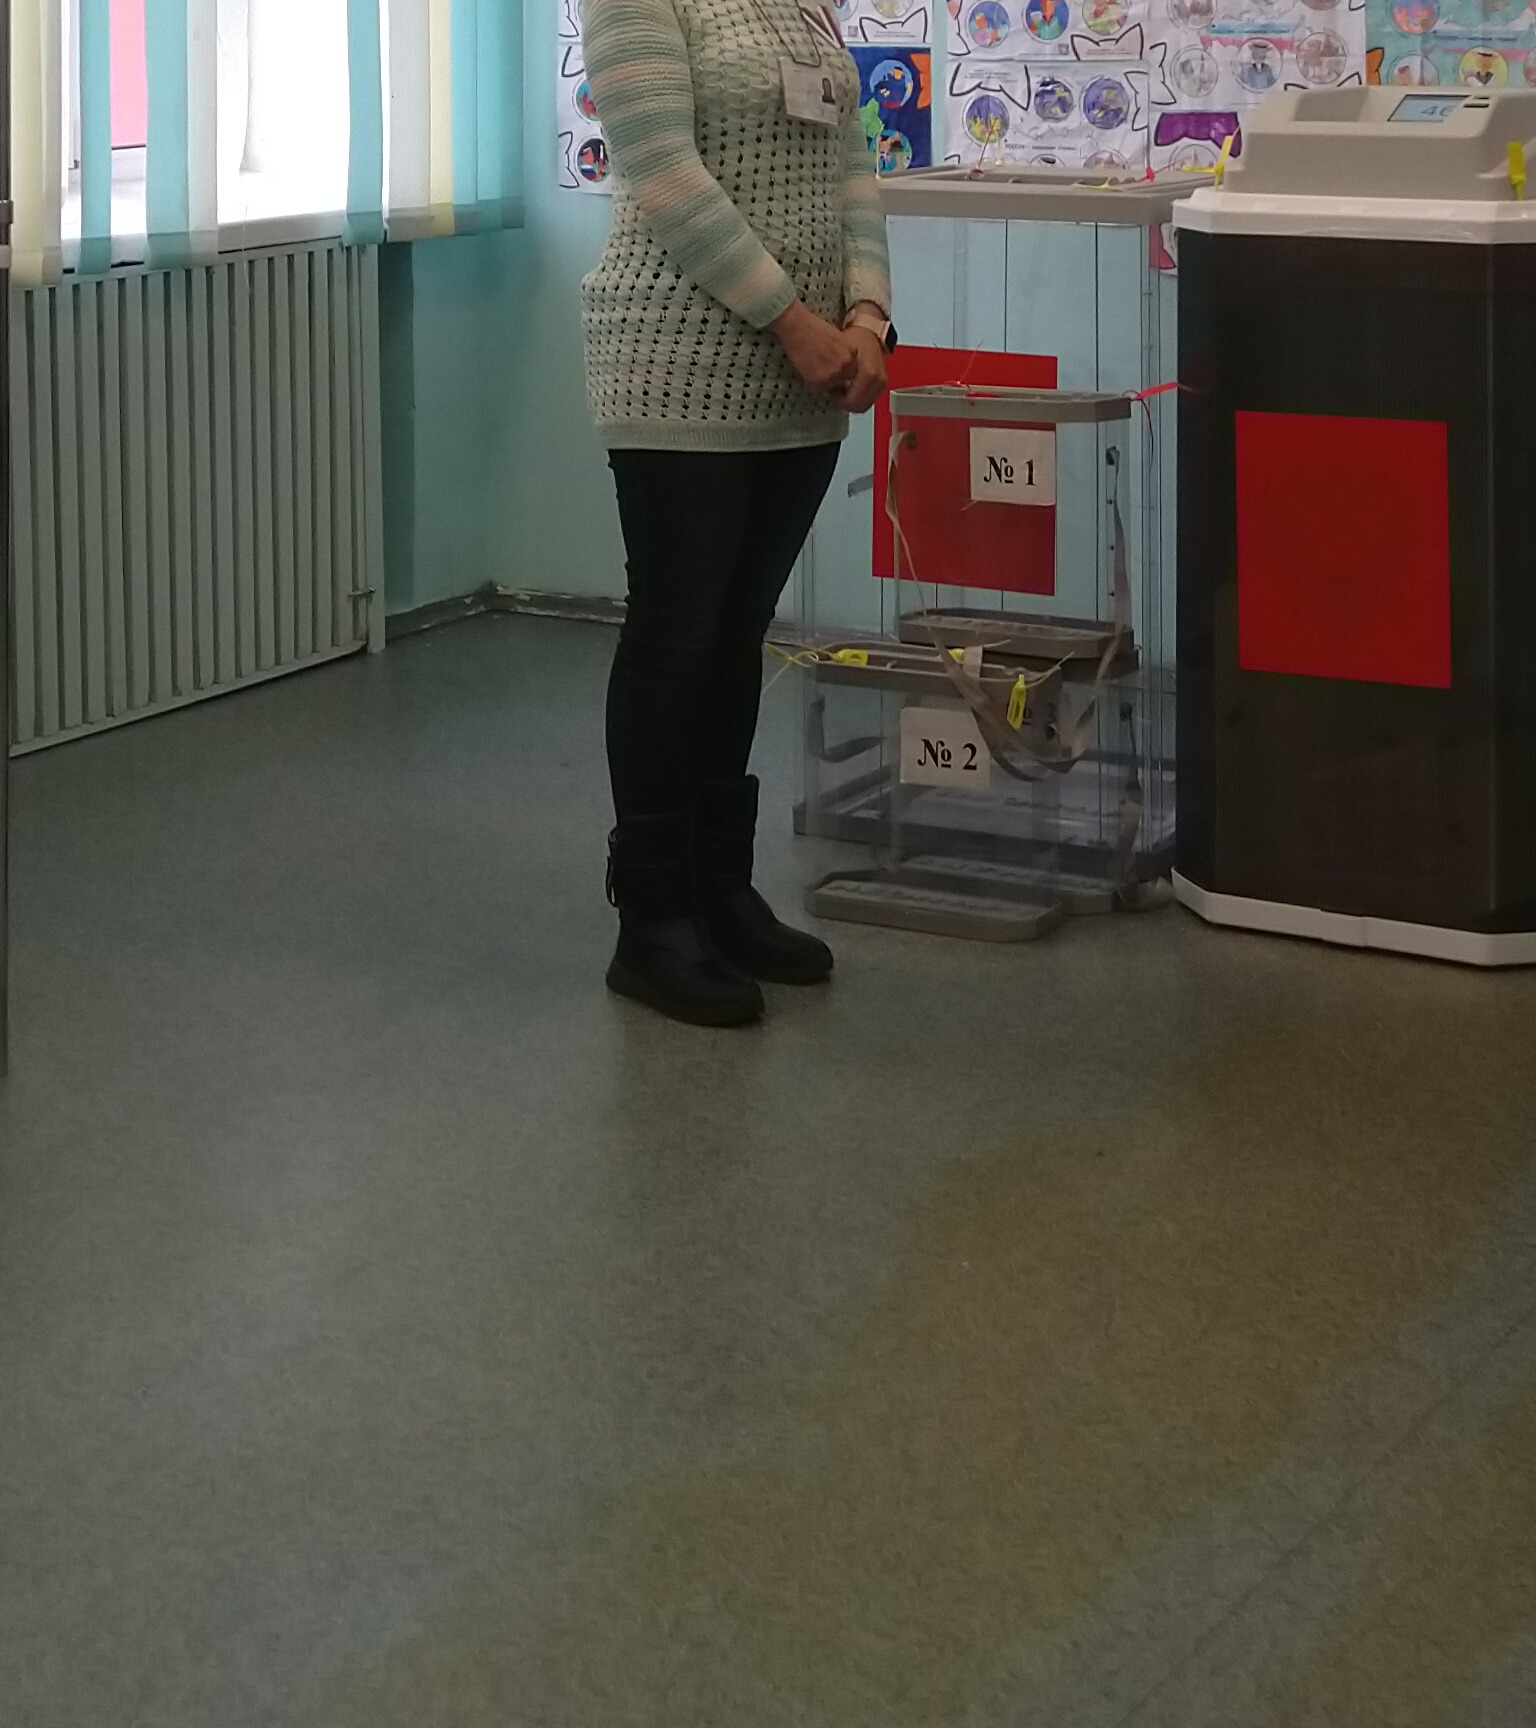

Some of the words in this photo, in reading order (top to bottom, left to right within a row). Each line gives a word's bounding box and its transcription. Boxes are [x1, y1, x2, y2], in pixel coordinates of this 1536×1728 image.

[983, 455, 1015, 484] №
[1025, 459, 1036, 486] 1
[917, 738, 952, 769] №
[962, 742, 978, 771] 2
